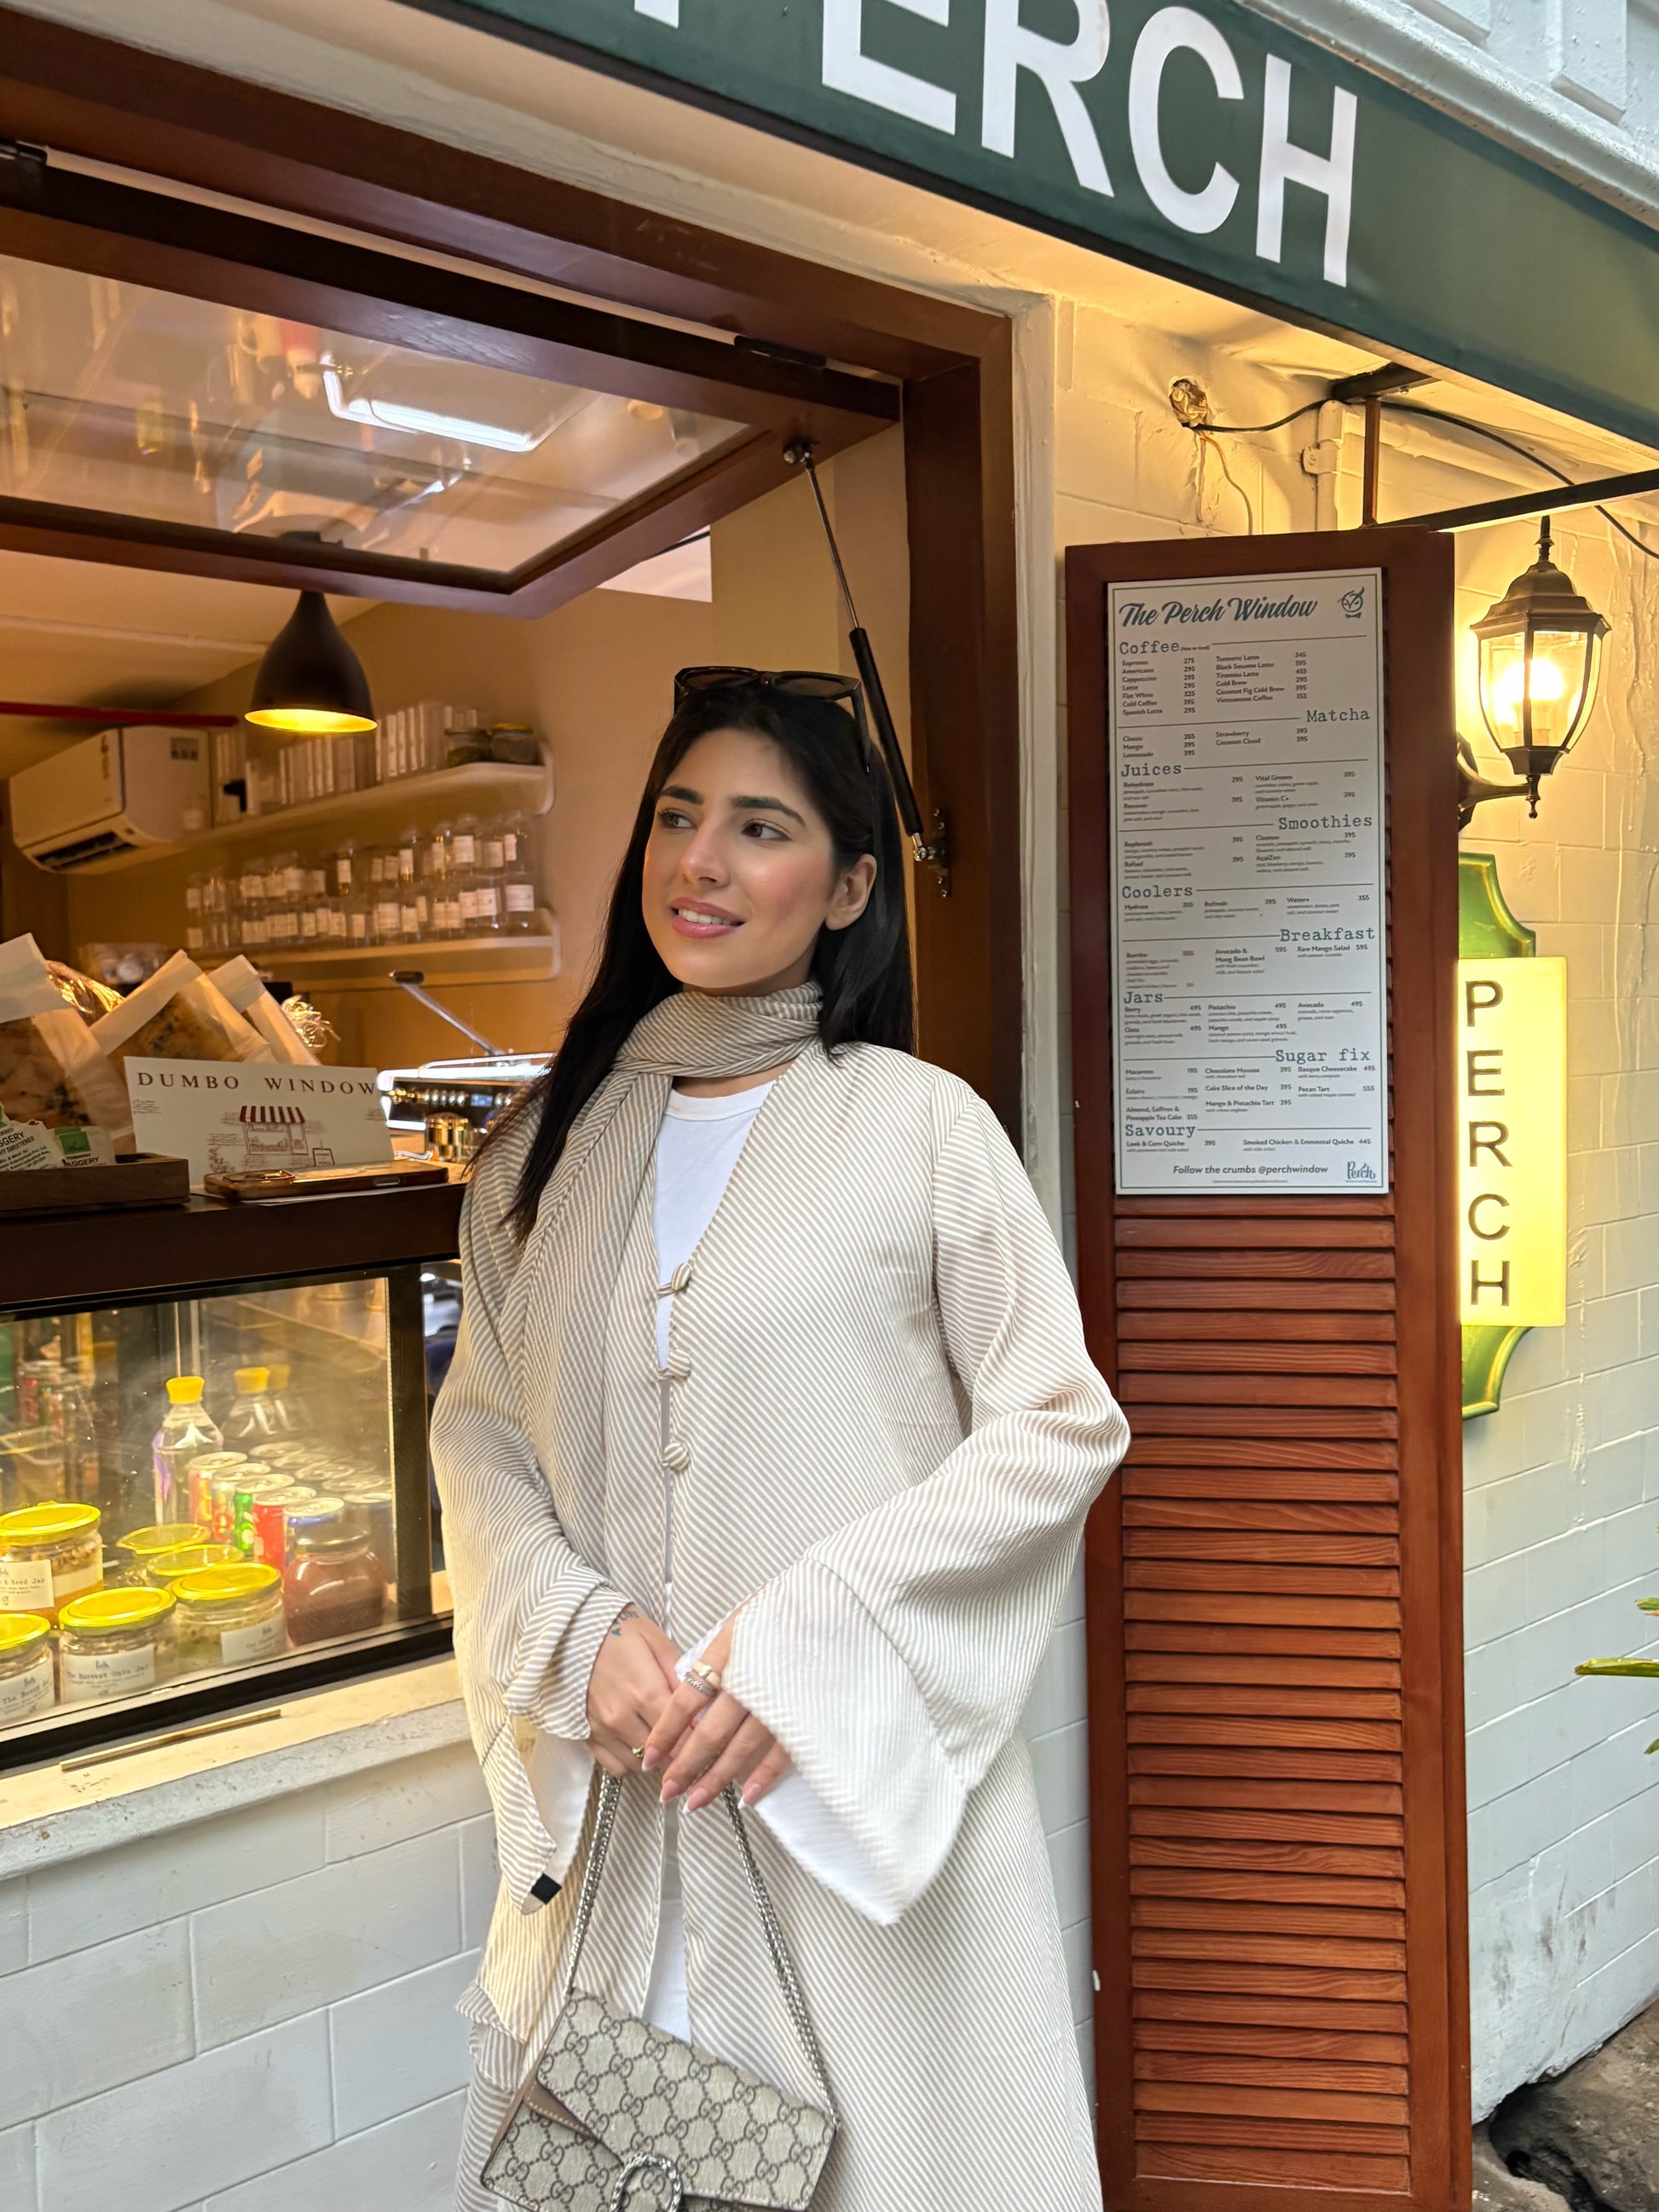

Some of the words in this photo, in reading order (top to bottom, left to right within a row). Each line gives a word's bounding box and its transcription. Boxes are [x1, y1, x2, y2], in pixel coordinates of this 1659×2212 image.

[634, 0, 1357, 287] ERCH
[1118, 602, 1159, 627] The
[1160, 598, 1227, 625] Perch
[1227, 594, 1318, 621] Window
[1119, 640, 1179, 655] Coffee
[1306, 707, 1370, 722] Matcha
[1120, 762, 1181, 777] Juices
[1278, 813, 1372, 829] Smoothies
[1121, 885, 1193, 898] Coolers
[1280, 927, 1375, 942] Breakfast
[1123, 990, 1163, 1003] Jars
[1275, 1048, 1327, 1065] Sugar
[1338, 1047, 1370, 1061] fix
[138, 1072, 239, 1089] DUMBO
[264, 1077, 375, 1095] WINDOW
[1124, 1123, 1196, 1138] Savoury
[1465, 980, 1512, 1306] PERCH
[1172, 1164, 1203, 1174] Follow
[1205, 1164, 1221, 1174] the
[1222, 1164, 1256, 1173] crumbs
[1257, 1164, 1327, 1175] @perchwindow
